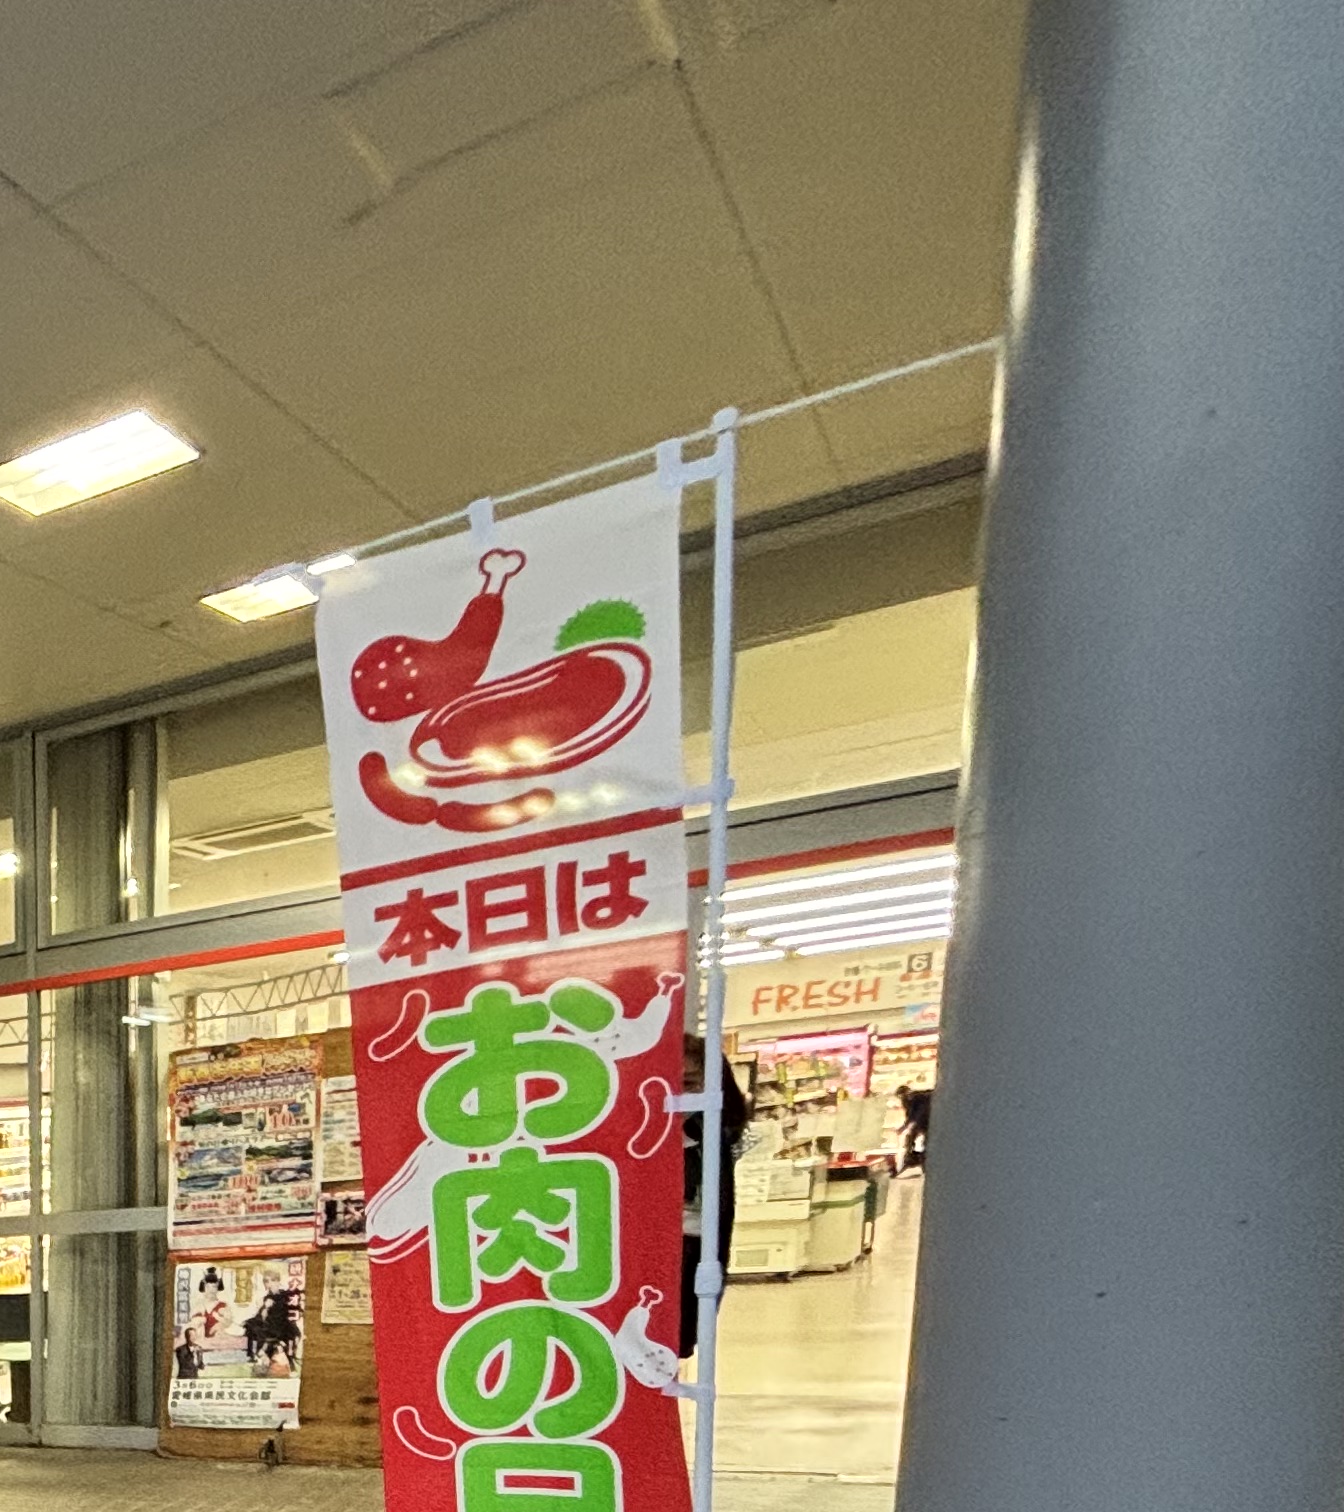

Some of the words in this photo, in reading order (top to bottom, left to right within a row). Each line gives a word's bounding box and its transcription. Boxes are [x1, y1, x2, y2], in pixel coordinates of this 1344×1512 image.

[374, 850, 649, 967] 本日は
[751, 977, 881, 1016] FRESH
